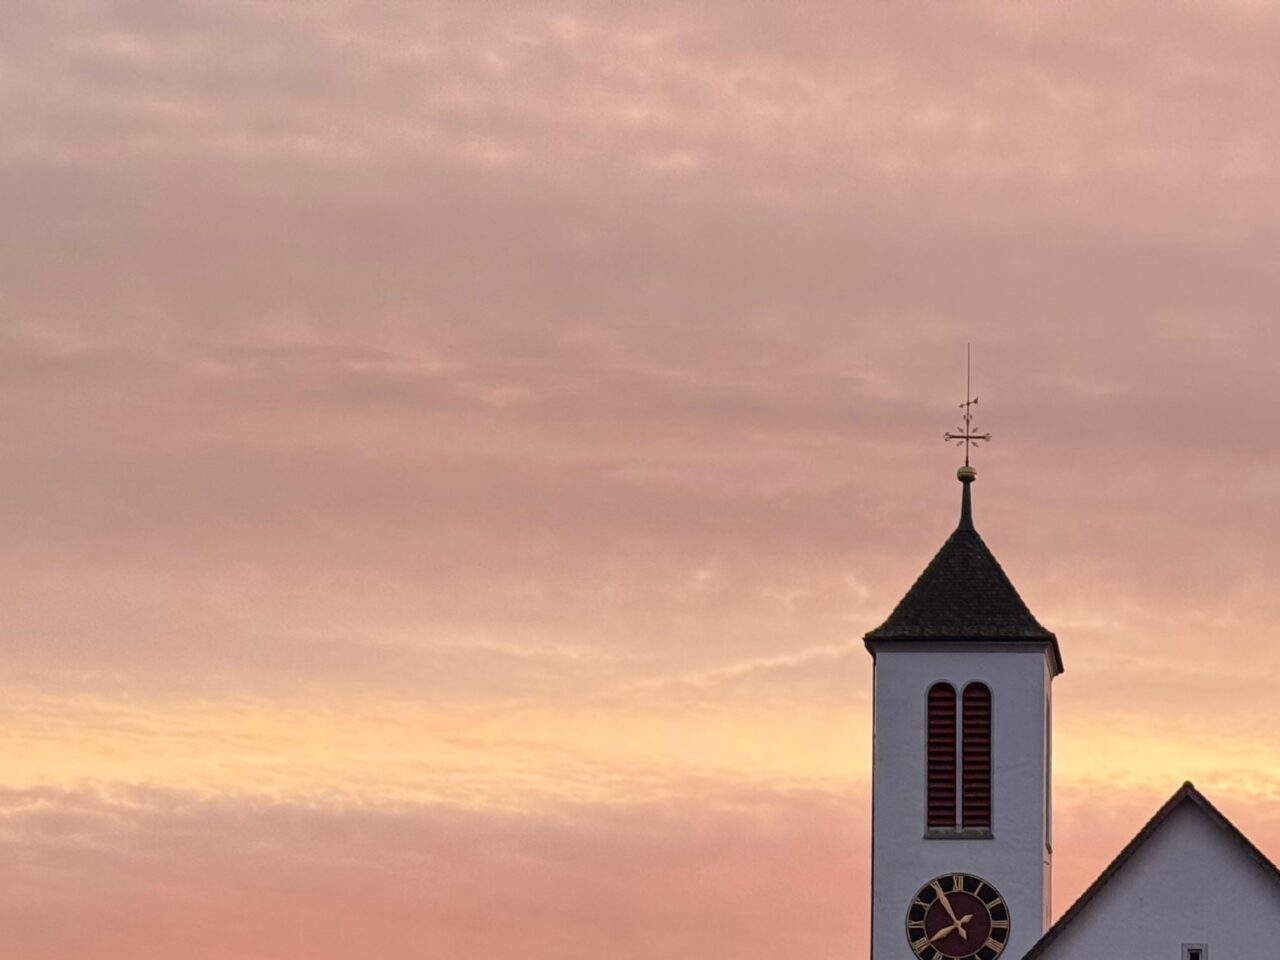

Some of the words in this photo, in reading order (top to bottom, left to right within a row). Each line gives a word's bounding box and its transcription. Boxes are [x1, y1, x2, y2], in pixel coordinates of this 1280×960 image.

[952, 876, 964, 891] XII
[974, 882, 983, 896] I
[985, 897, 1002, 908] II
[908, 920, 925, 928] IX
[991, 920, 1009, 928] III
